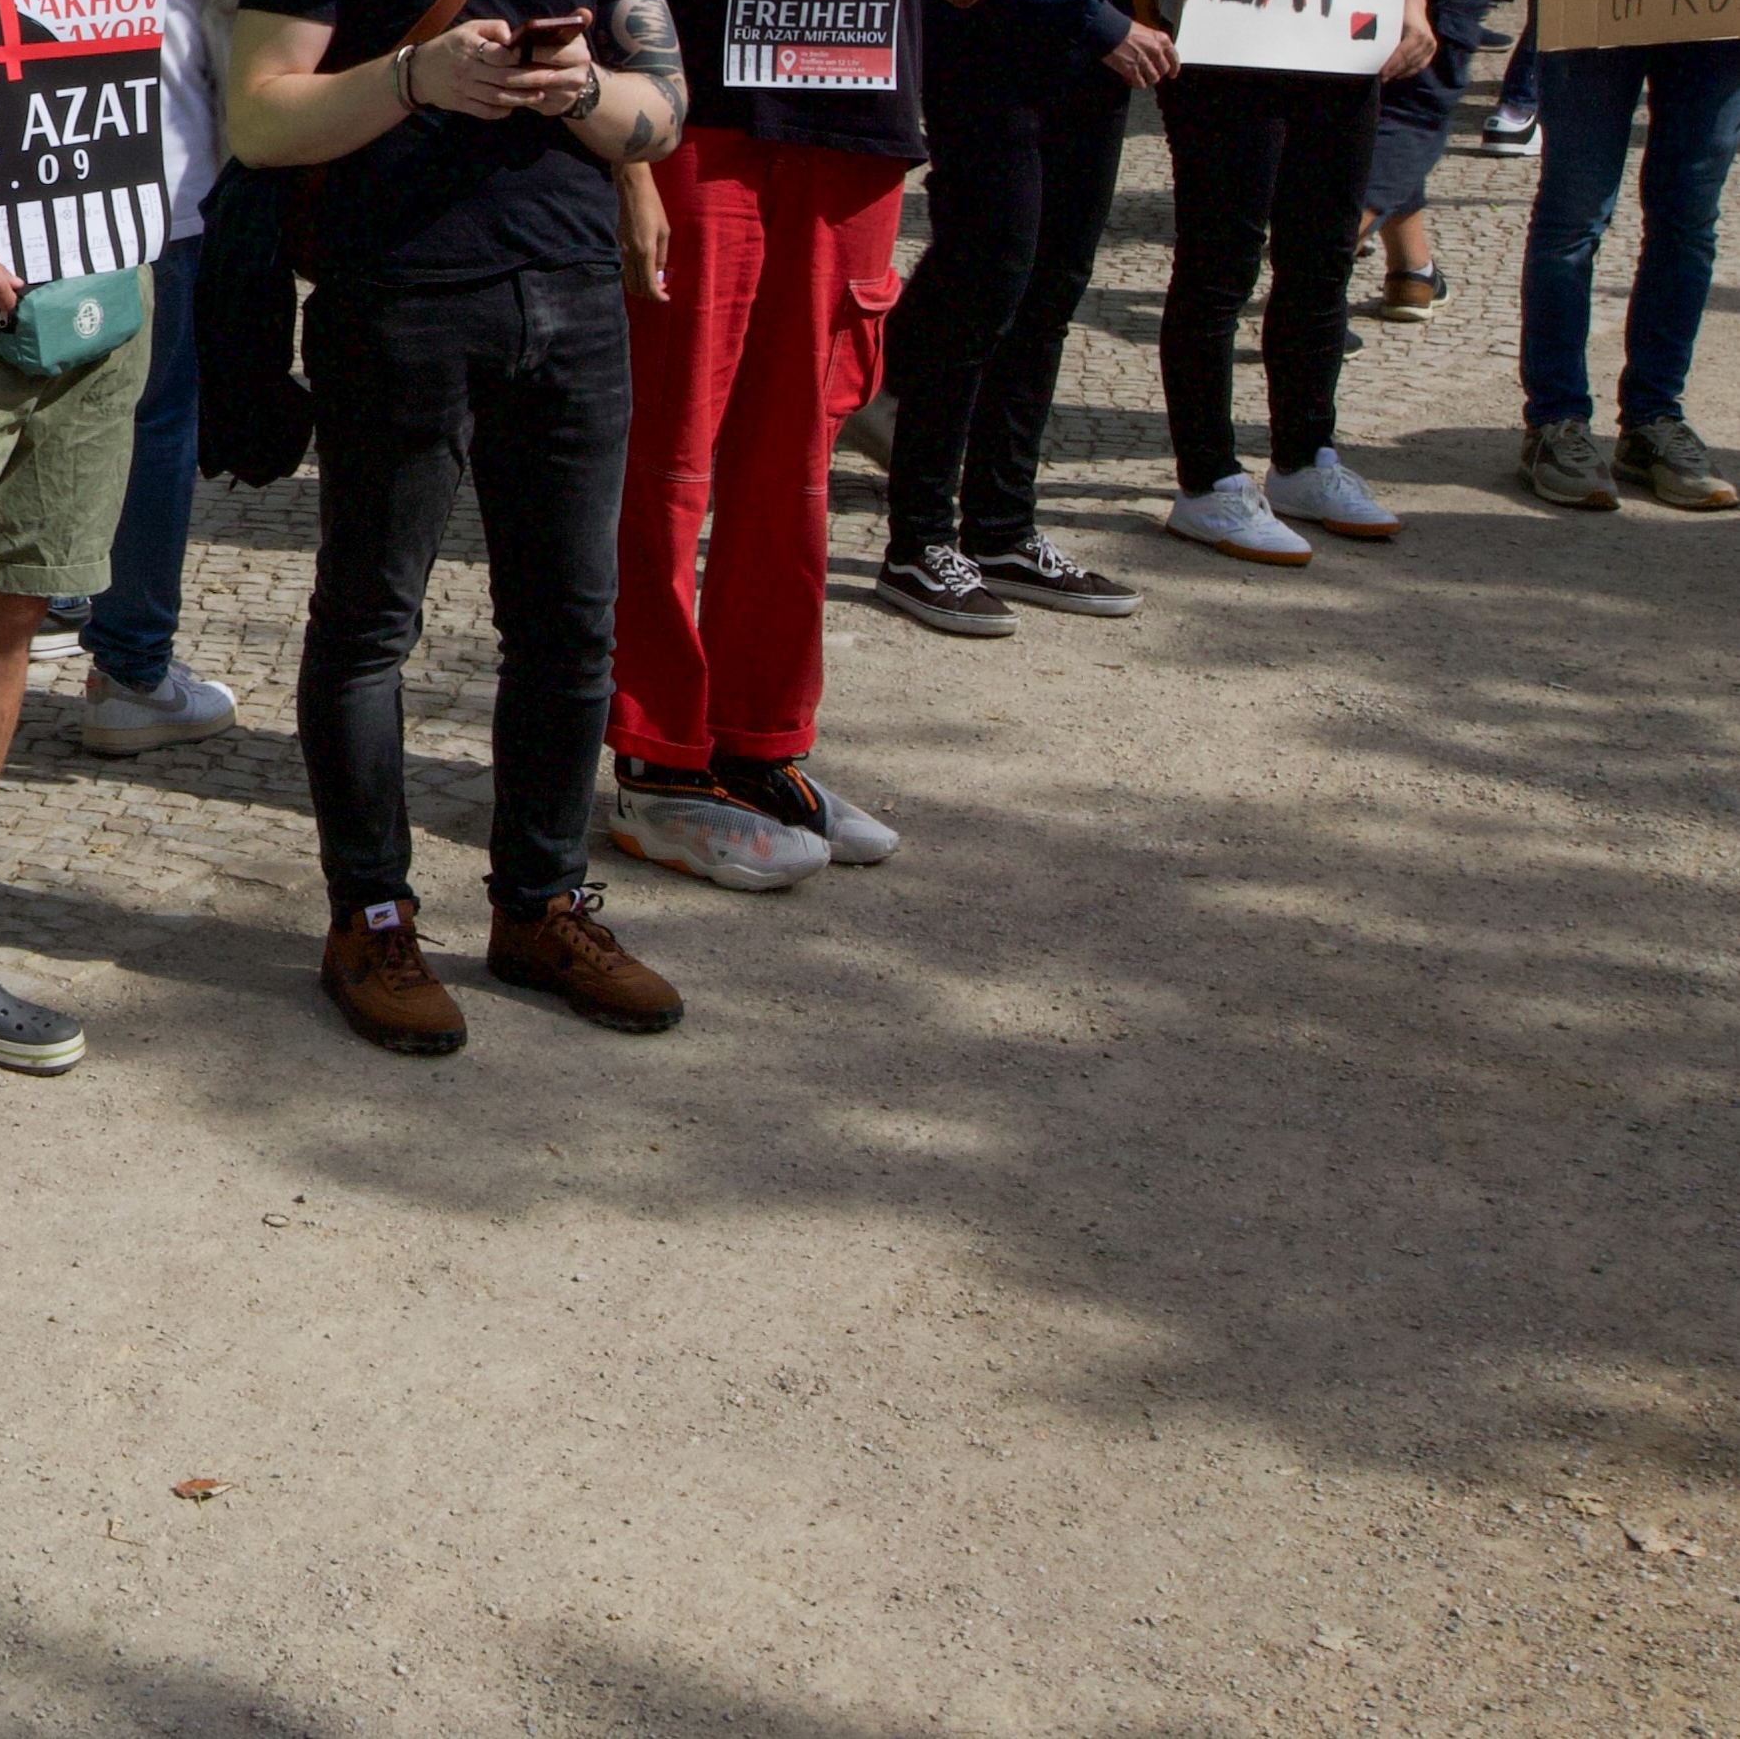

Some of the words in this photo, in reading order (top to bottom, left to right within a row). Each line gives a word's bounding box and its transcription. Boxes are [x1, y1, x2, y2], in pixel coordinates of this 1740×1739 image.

[733, 24, 760, 41] FÜR
[764, 28, 801, 42] AZAT
[803, 30, 887, 44] MIFTAKHOV
[21, 76, 159, 152] AZAT
